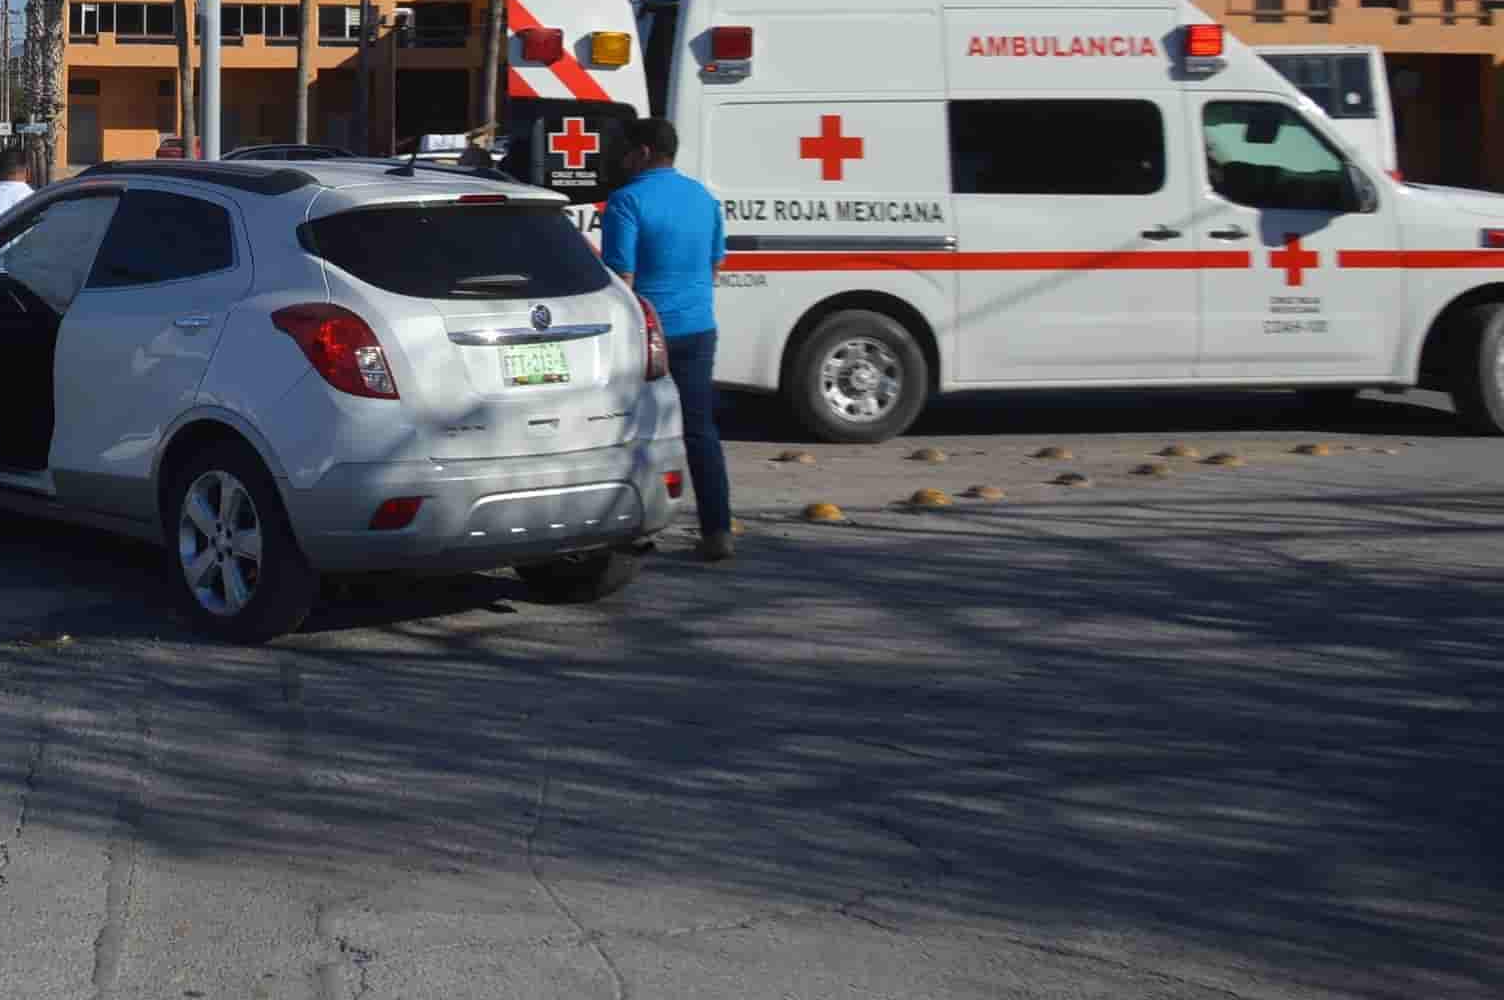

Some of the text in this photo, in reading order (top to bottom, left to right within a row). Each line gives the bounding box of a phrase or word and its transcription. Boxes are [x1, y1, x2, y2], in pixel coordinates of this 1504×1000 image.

[966, 35, 1158, 57] AMBULANCIA
[720, 200, 945, 223] RUZ ROJA MEXICANA
